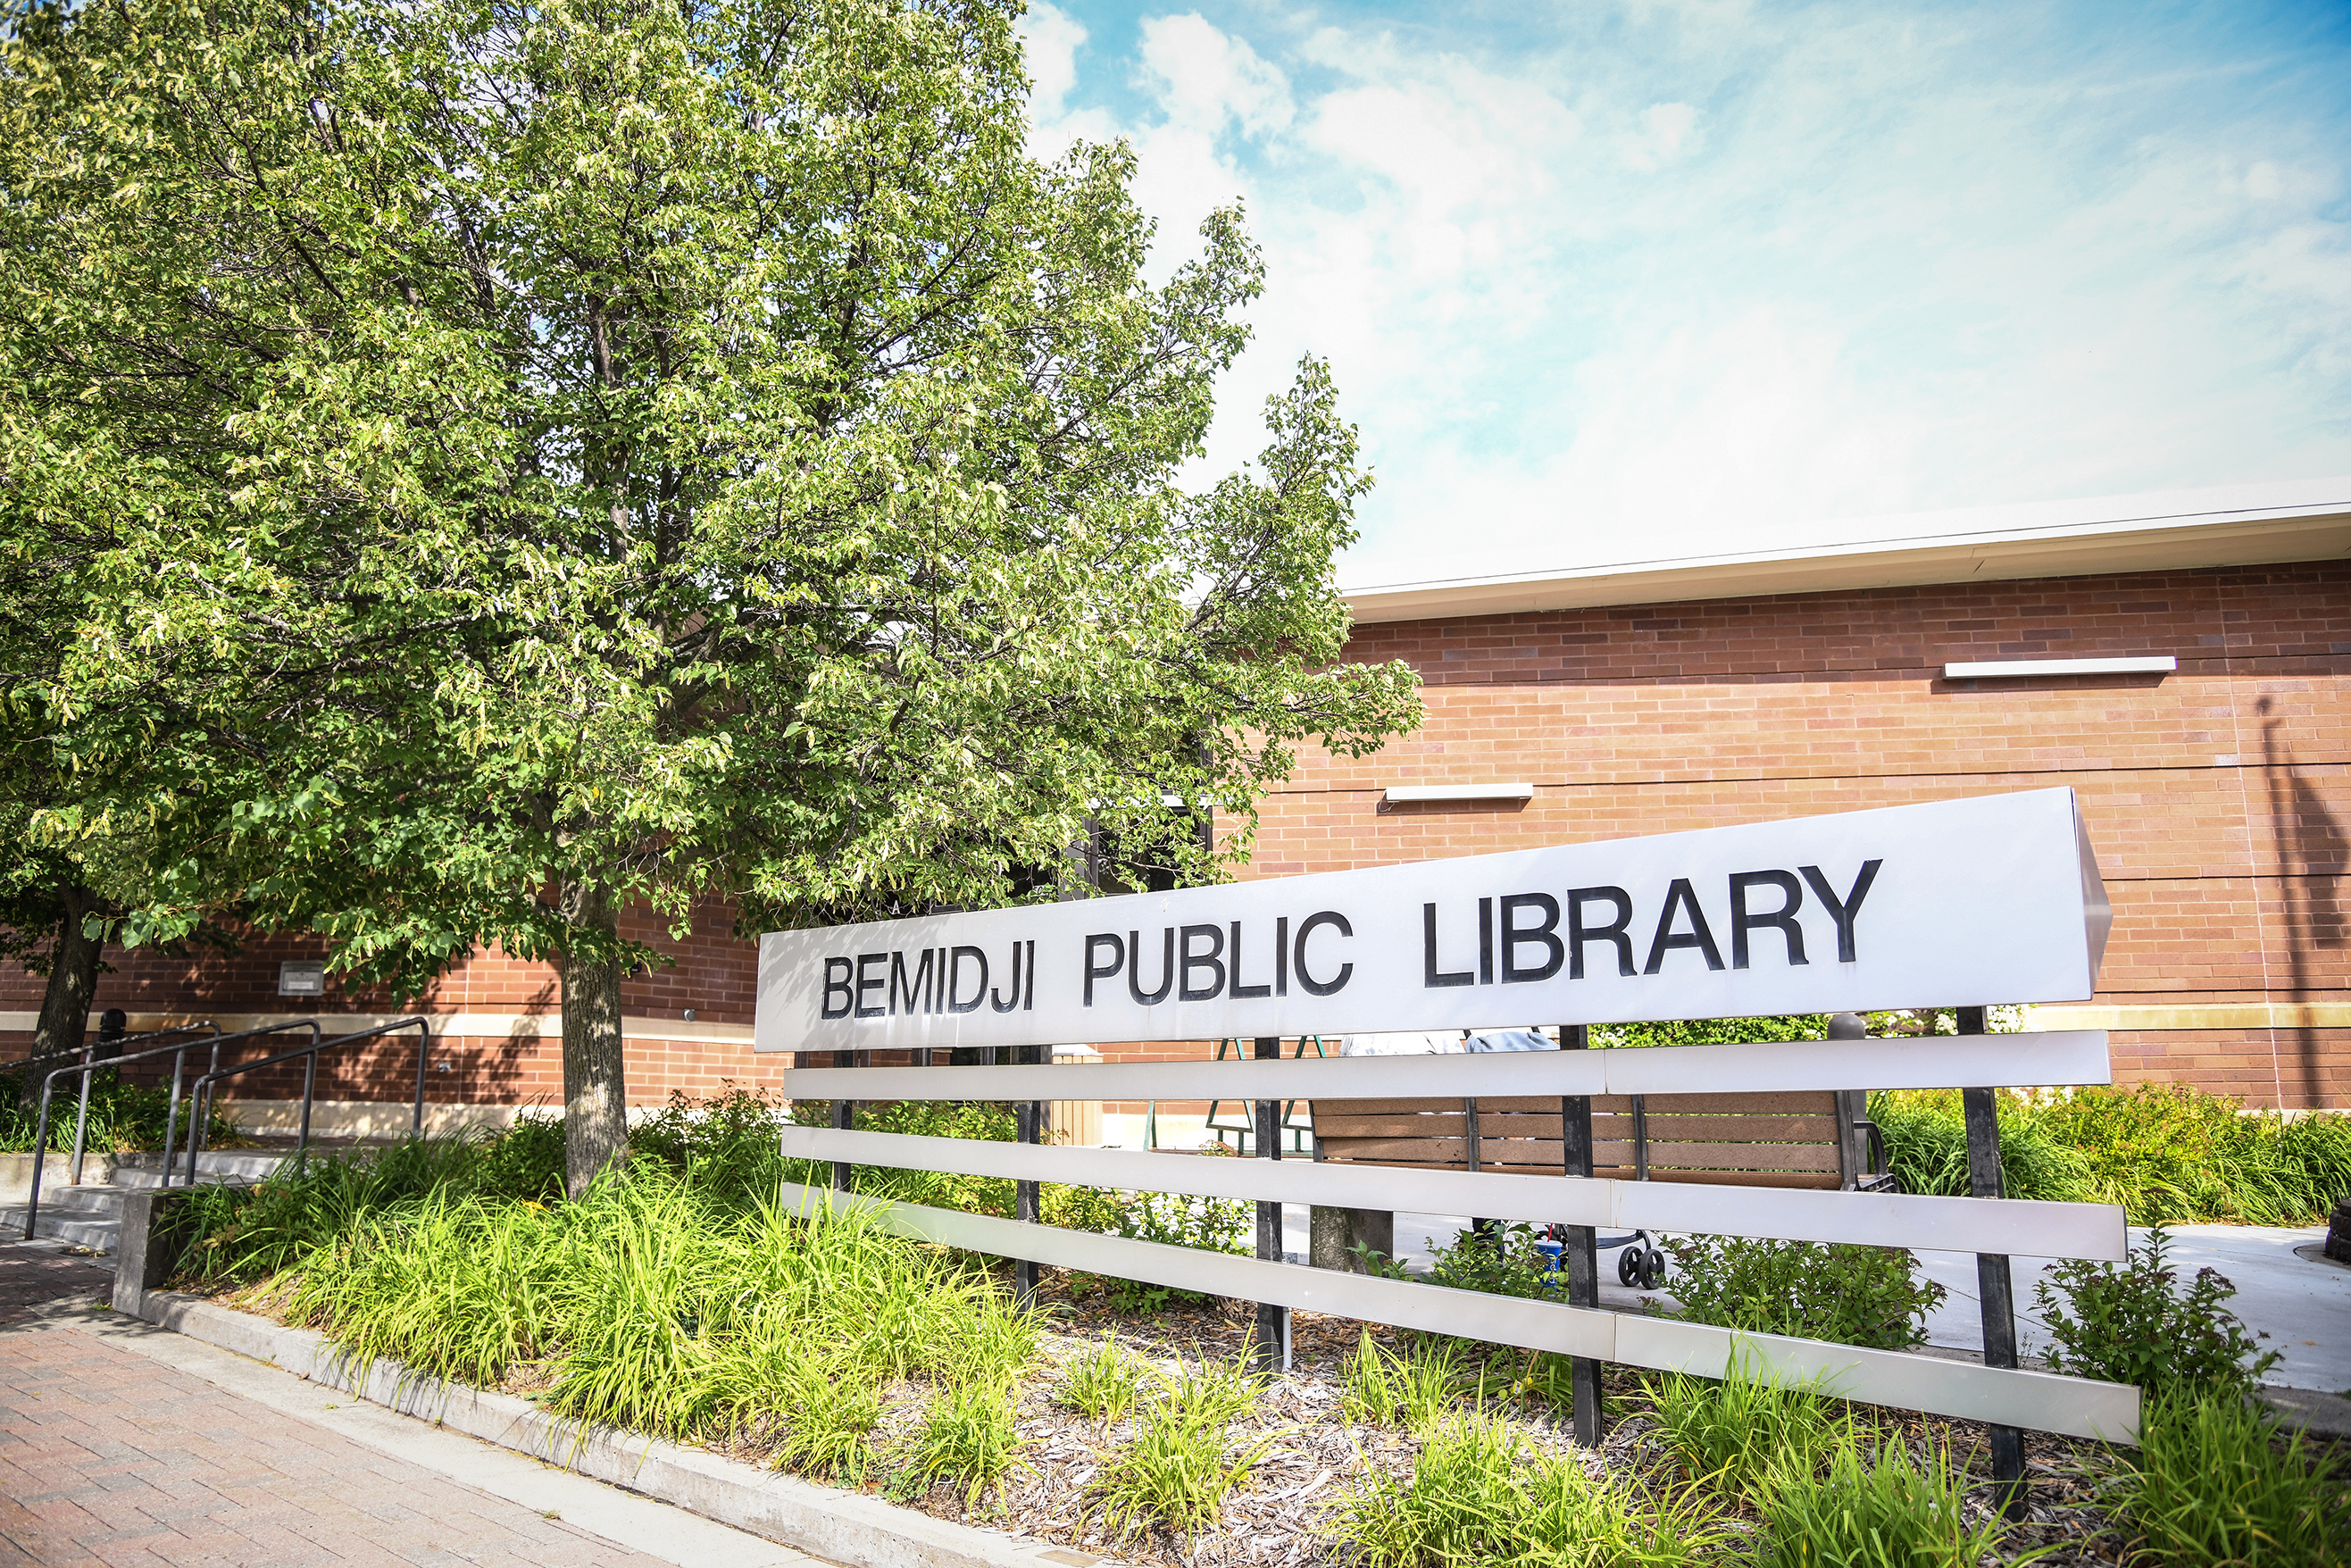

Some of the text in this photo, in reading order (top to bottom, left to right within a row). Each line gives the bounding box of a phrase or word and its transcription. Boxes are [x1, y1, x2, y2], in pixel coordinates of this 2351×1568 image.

[821, 859, 1883, 1020] BEMIDJI PUBLIC LIBRARY
